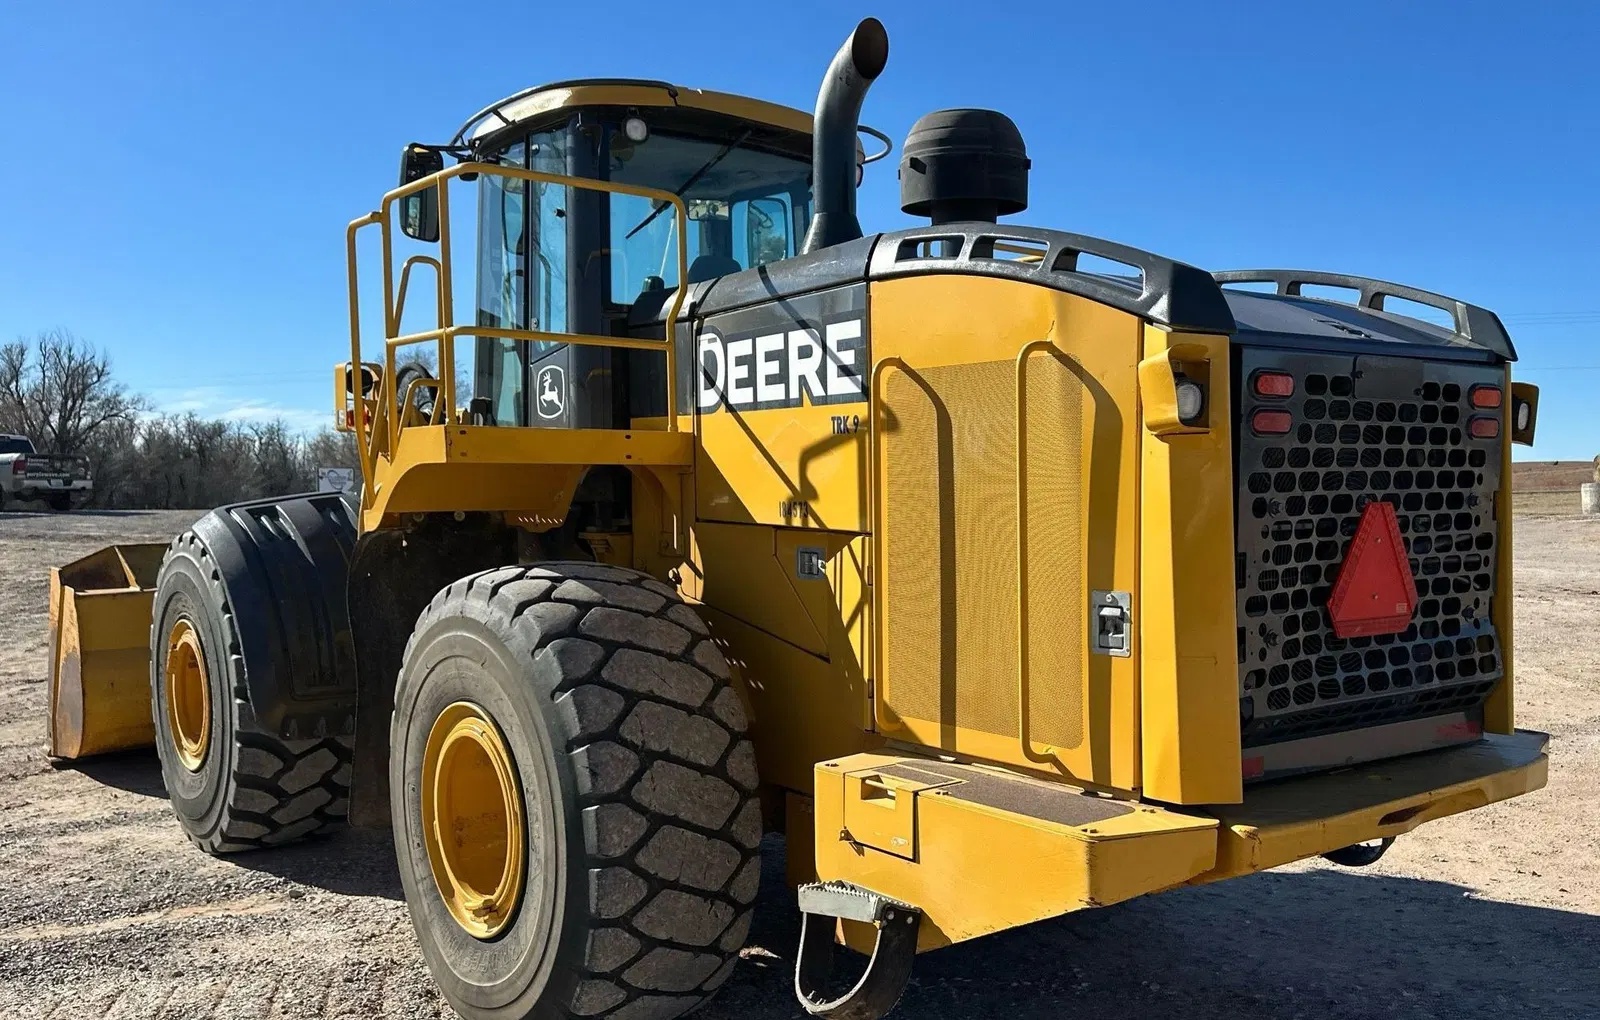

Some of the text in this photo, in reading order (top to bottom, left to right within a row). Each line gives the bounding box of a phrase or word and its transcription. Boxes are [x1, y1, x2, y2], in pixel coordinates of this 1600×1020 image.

[698, 319, 862, 407] DEERE
[831, 415, 860, 434] TRK 9
